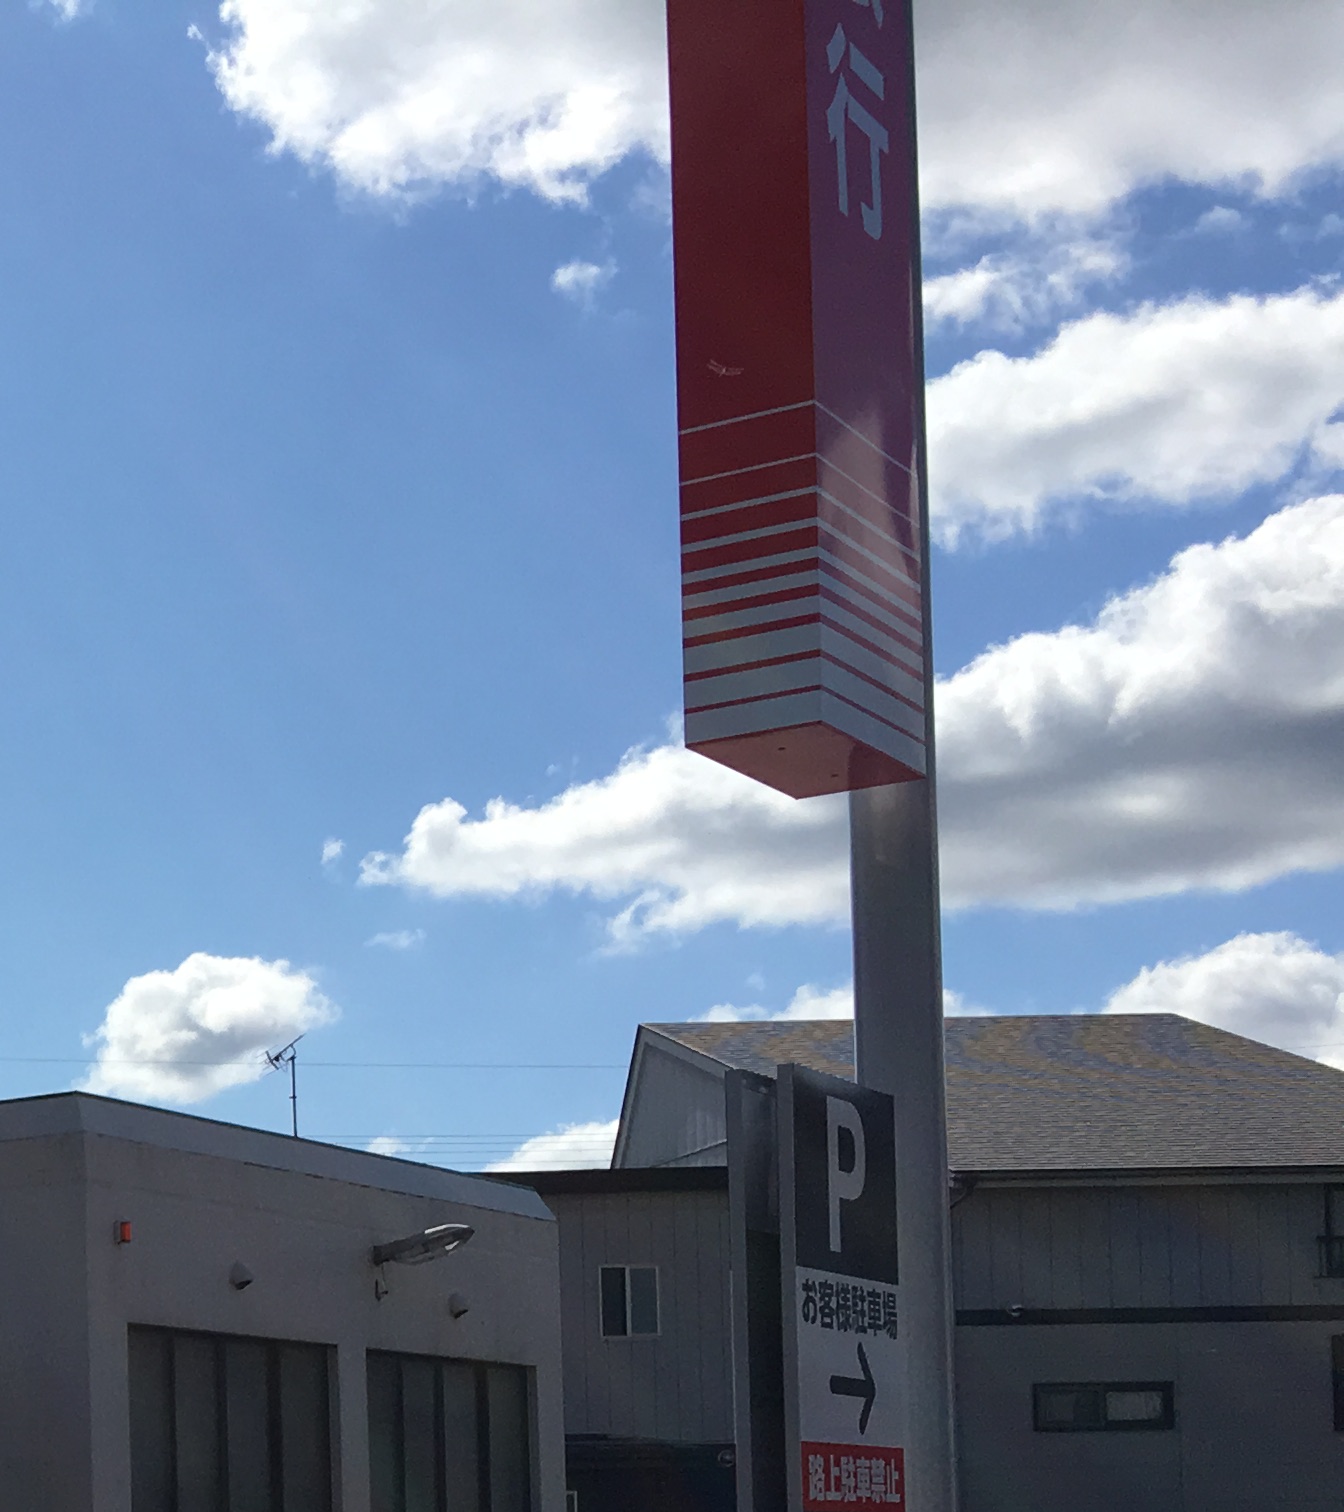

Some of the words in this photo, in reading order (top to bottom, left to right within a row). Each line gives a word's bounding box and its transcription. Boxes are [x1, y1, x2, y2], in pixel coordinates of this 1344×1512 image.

[827, 1095, 865, 1253] P
[802, 1278, 897, 1340] お客様駐車場
[809, 1454, 900, 1503] 路上駐車禁止
